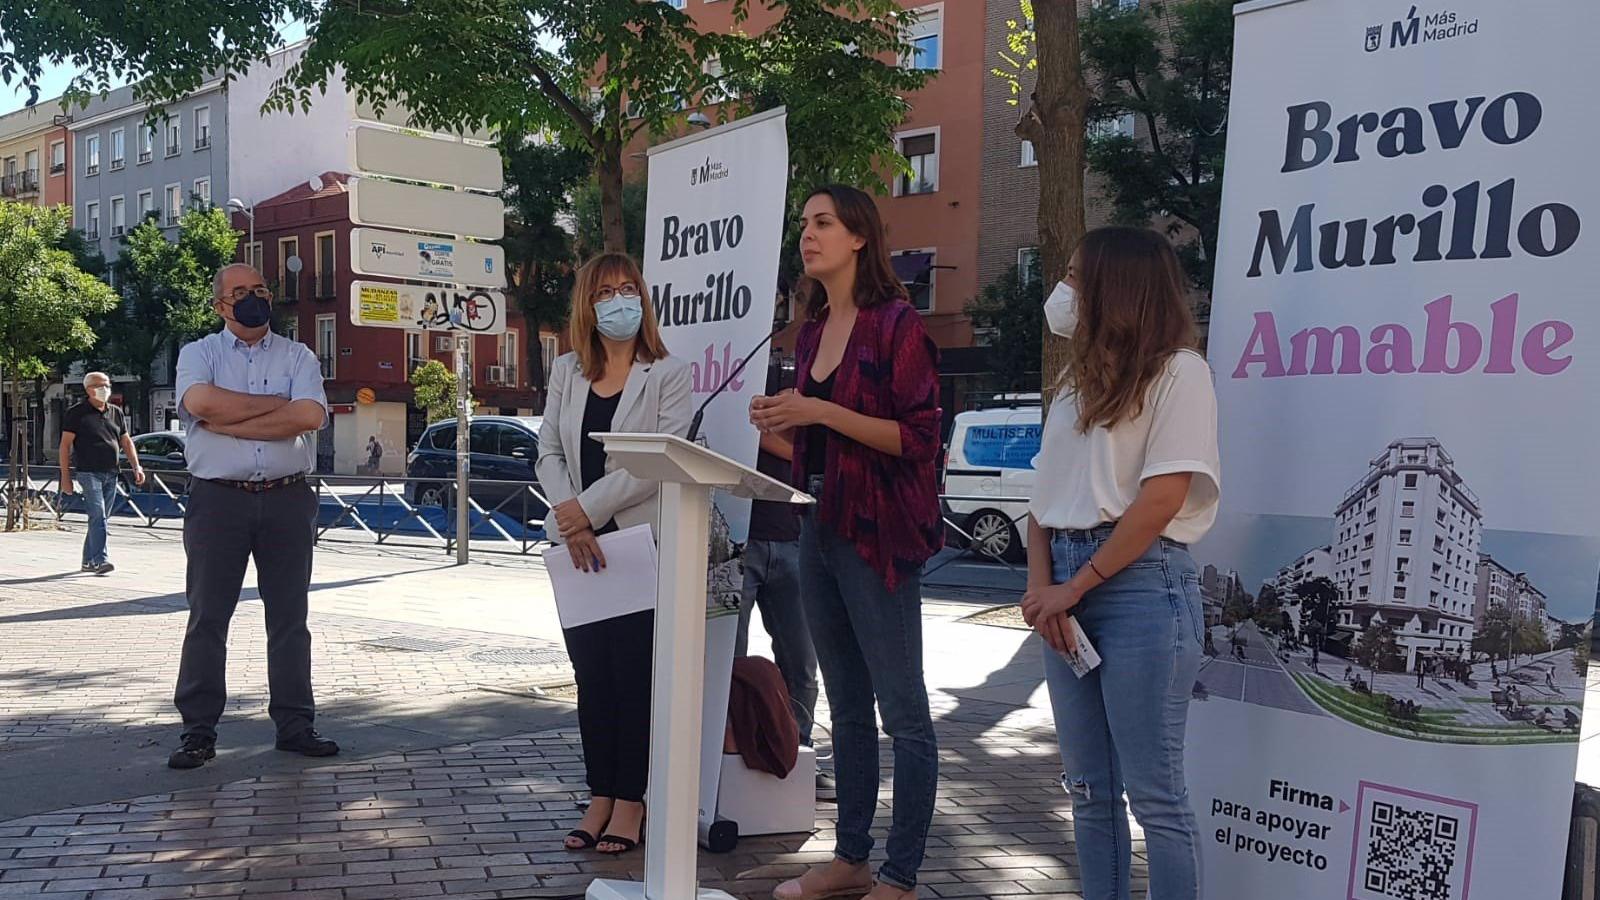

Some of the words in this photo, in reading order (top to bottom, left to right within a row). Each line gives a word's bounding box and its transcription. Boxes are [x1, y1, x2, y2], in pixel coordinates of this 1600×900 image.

[1423, 19, 1479, 42] Madrid
[1424, 10, 1457, 28] Más
[1280, 91, 1543, 173] Bravo
[660, 214, 744, 262] Bravo
[1246, 177, 1581, 278] Murillo
[652, 269, 752, 328] Murillo
[1231, 292, 1575, 379] Amable
[1269, 779, 1334, 811] Firma
[1211, 798, 1251, 821] para
[1255, 810, 1332, 840] apoyar
[1215, 827, 1231, 845] el
[1234, 833, 1328, 871] proyecto
